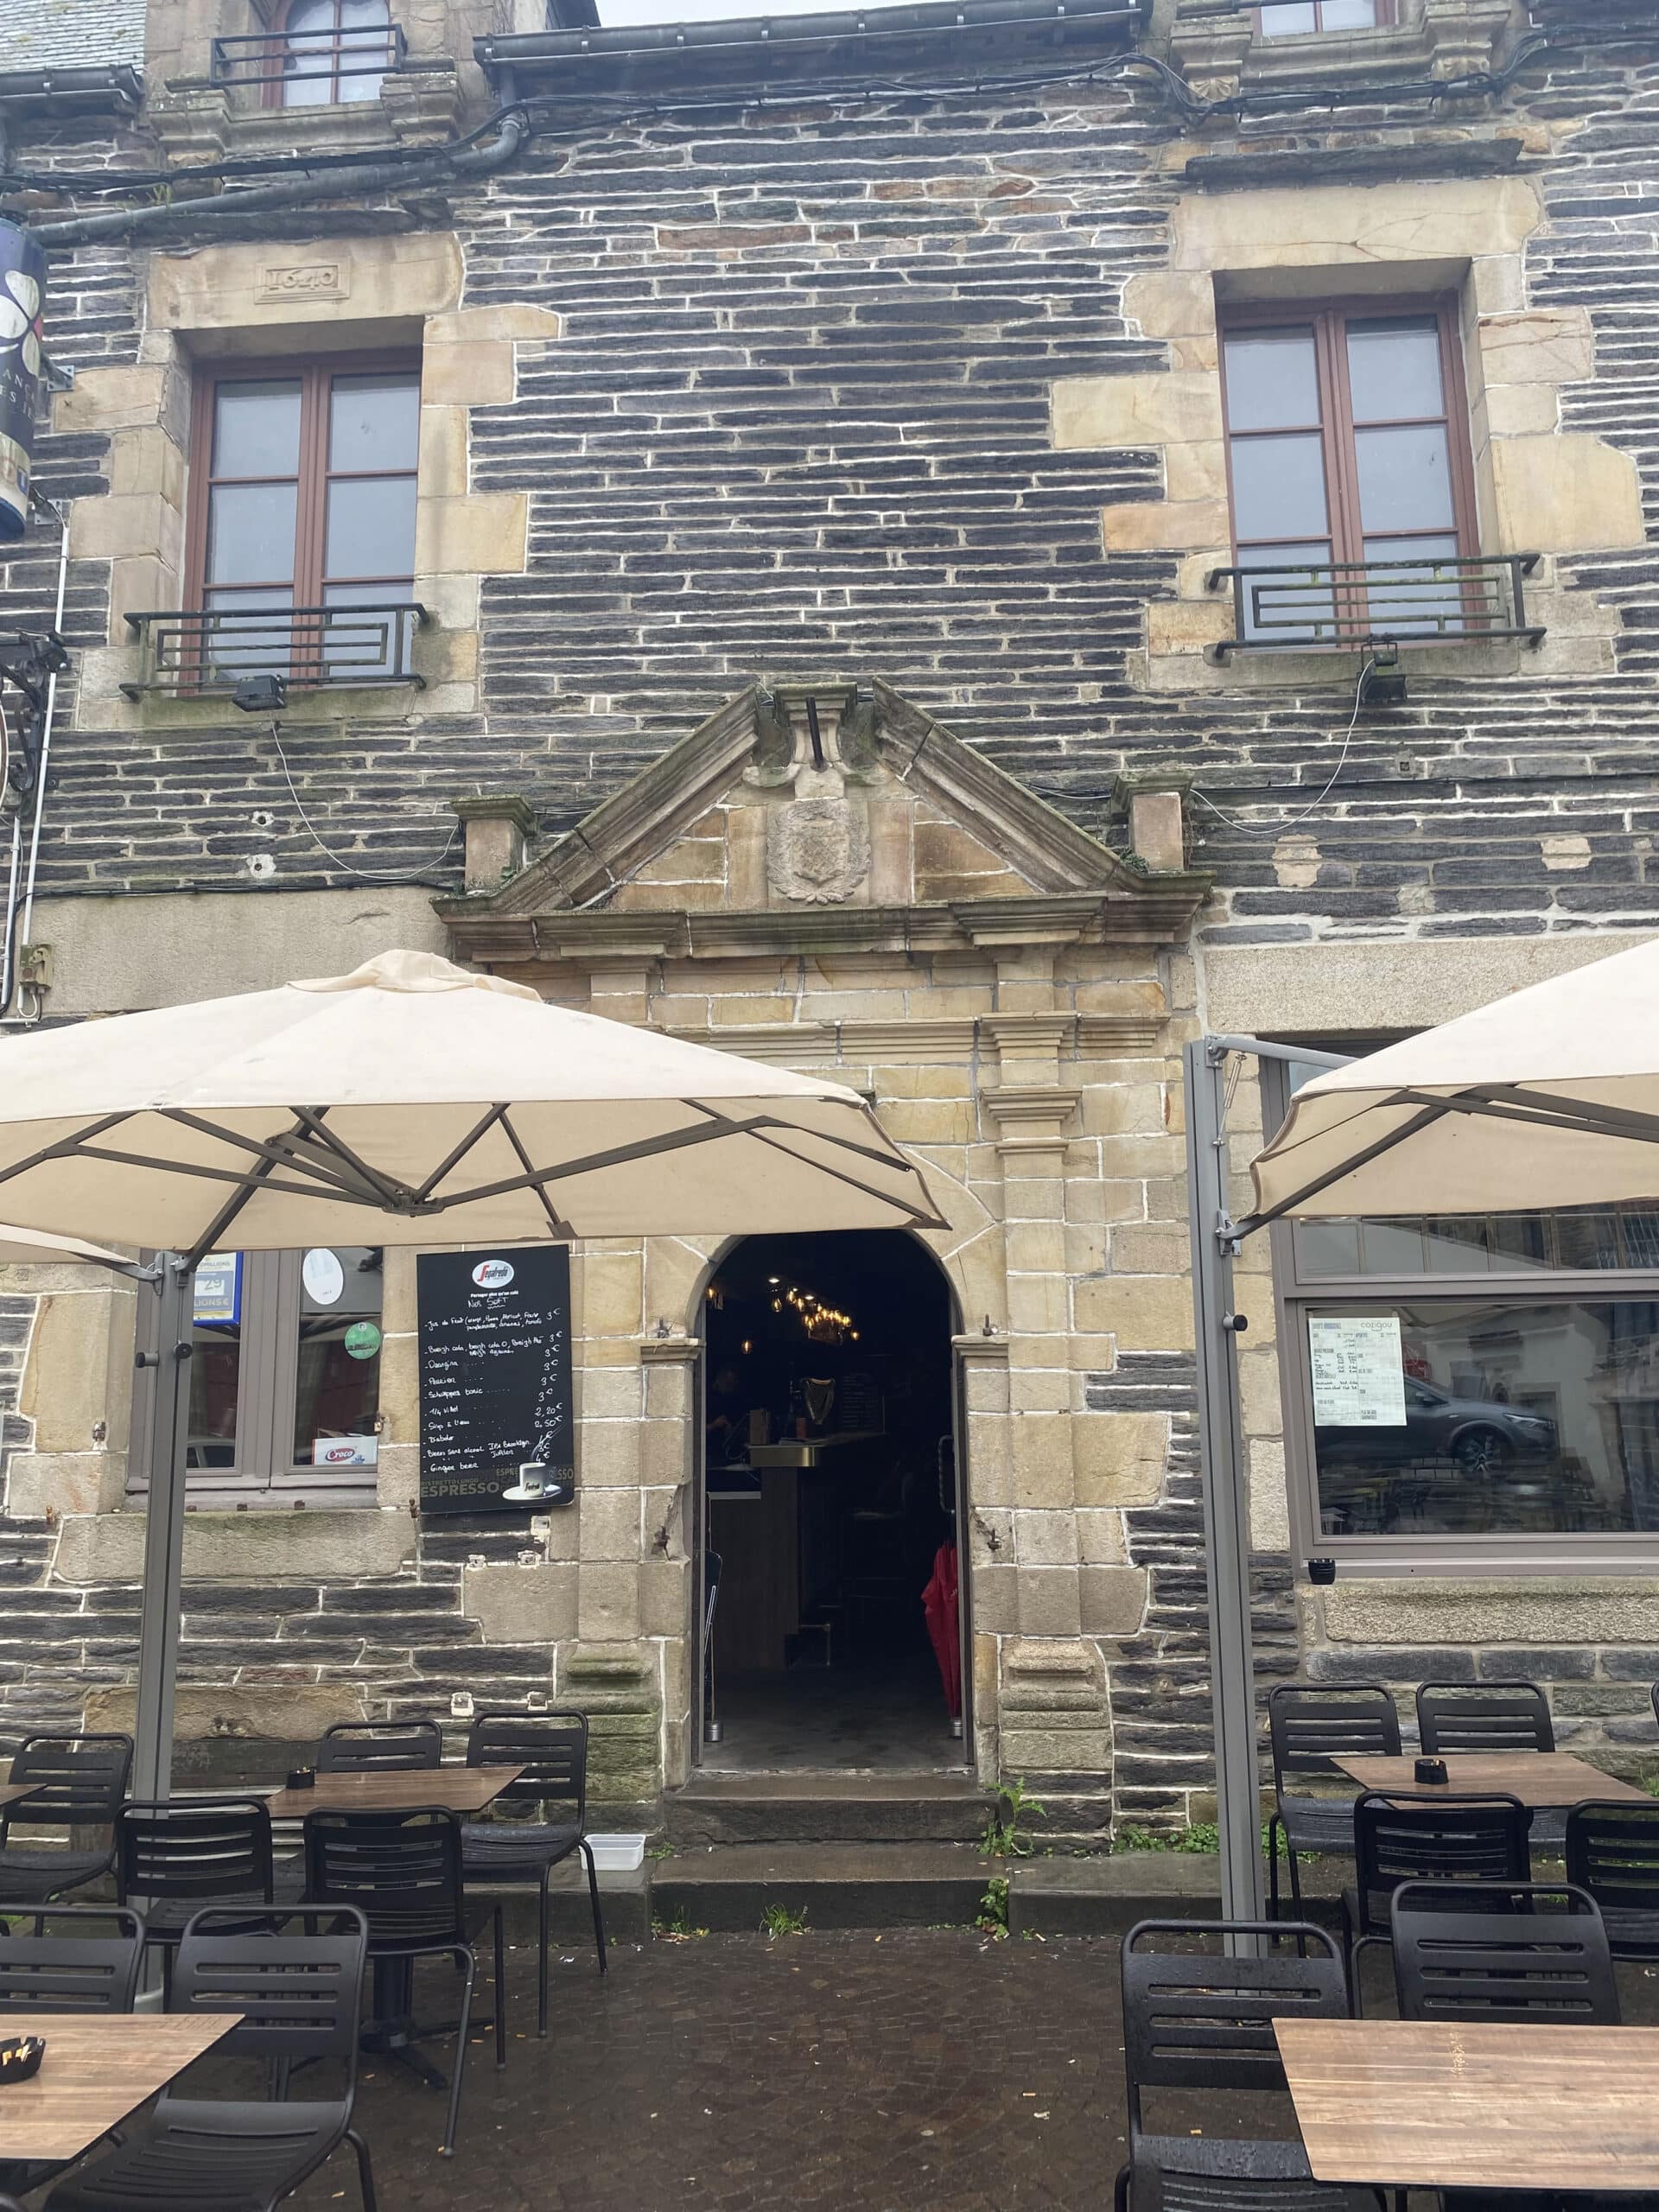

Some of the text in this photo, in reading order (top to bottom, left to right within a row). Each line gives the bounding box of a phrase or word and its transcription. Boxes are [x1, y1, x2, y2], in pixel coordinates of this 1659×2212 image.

[204, 1279, 222, 1291] 29
[194, 1298, 222, 1306] LIONS
[327, 1450, 353, 1460] Croco
[420, 1481, 500, 1498] ESPRESSO
